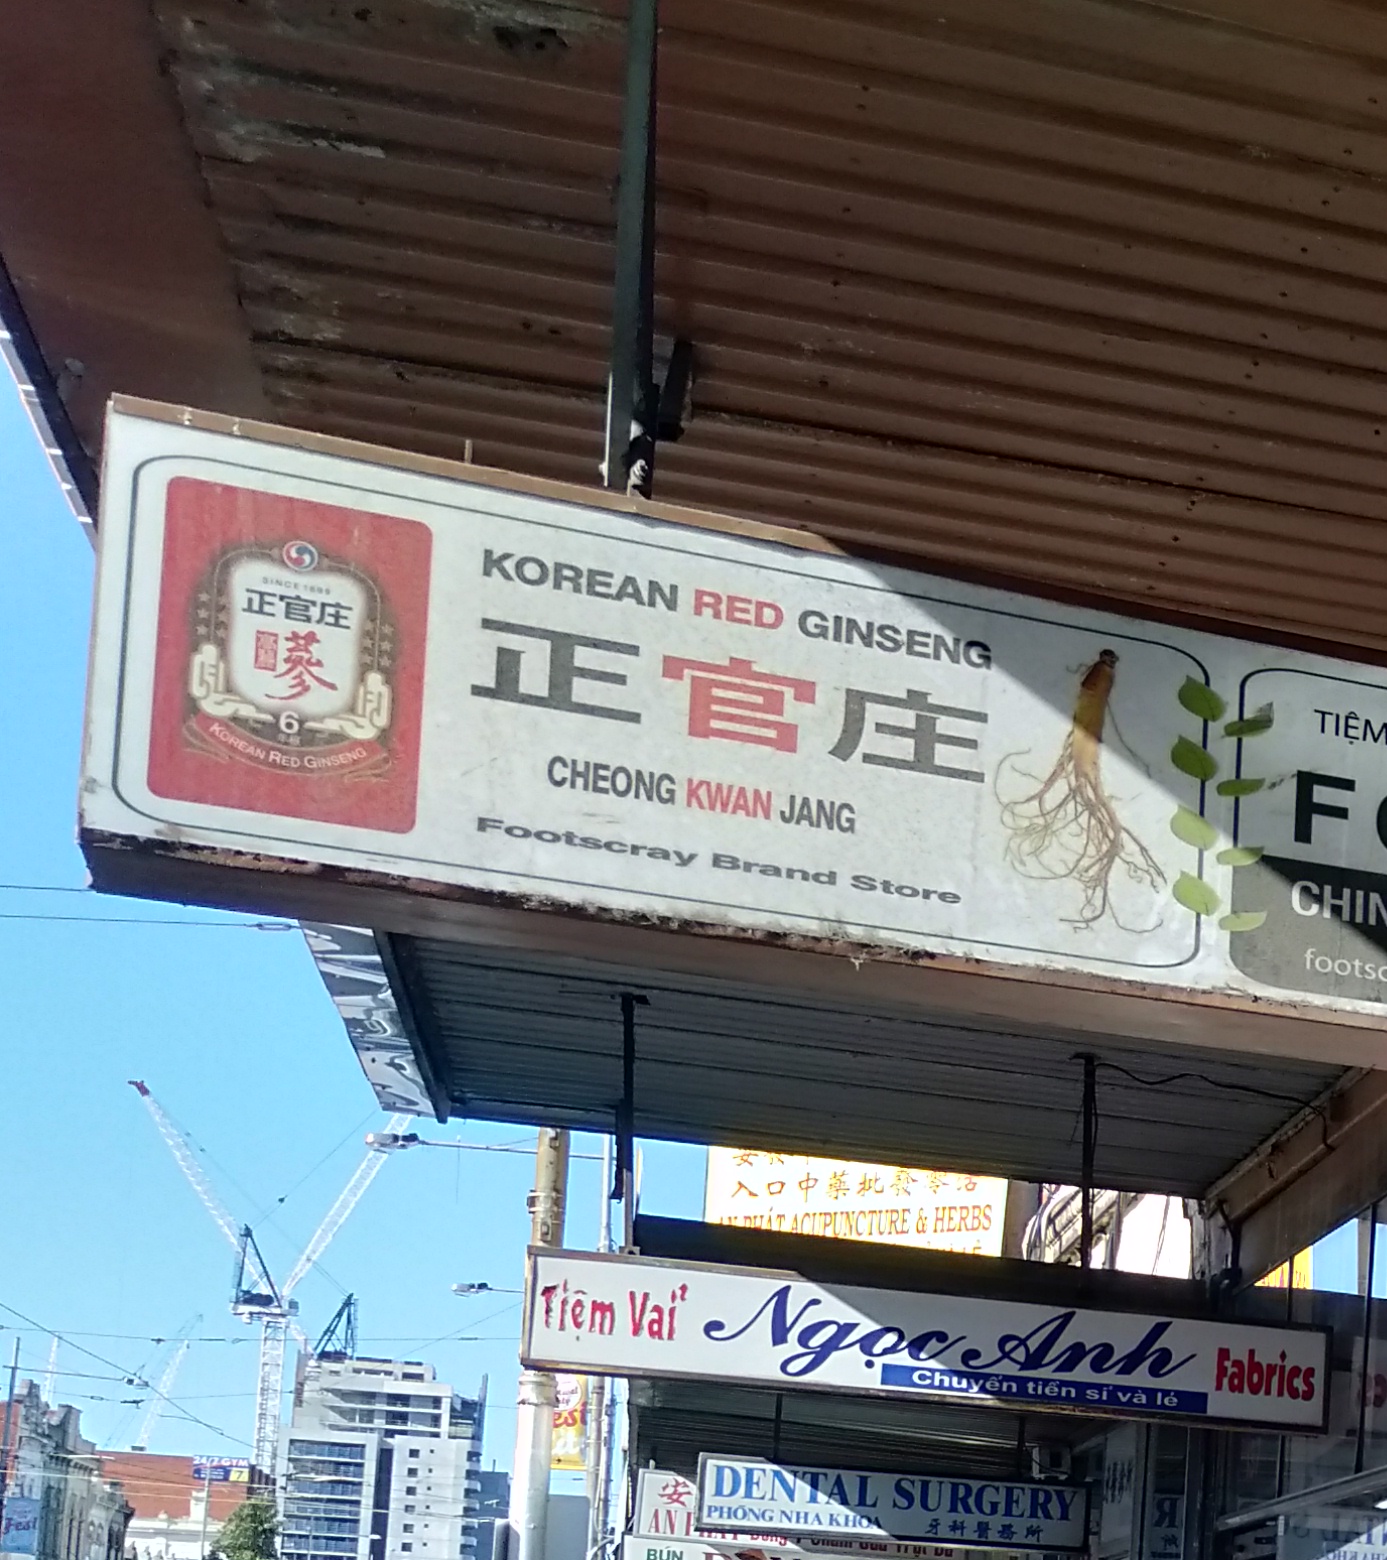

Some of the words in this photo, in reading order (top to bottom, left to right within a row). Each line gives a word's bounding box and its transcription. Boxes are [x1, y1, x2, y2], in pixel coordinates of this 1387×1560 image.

[262, 577, 299, 590] SINCE
[241, 587, 354, 629] 正官庄
[482, 549, 678, 612] KOREAN
[693, 589, 783, 630] RED
[798, 609, 993, 670] GINSENG
[470, 617, 988, 783] 正官庄
[278, 710, 300, 734] 6
[268, 750, 300, 768] RED
[303, 747, 368, 768] GINSENG
[547, 755, 675, 806] CHEONG
[686, 778, 771, 820] KWAN
[779, 794, 855, 834] JANG
[476, 817, 697, 867] Footscray
[711, 852, 836, 886] Brand
[850, 875, 961, 904] Store
[790, 1208, 912, 1238] ACUPUNCTURE
[915, 1207, 928, 1234] &
[933, 1204, 993, 1234] HERBS
[702, 1284, 967, 1377] Ngọc
[962, 1310, 1199, 1379] Anh
[1215, 1346, 1317, 1402] Fabrics
[1120, 1387, 1148, 1405] và
[221, 1457, 249, 1467] GYM
[657, 1476, 692, 1508] 安
[712, 1463, 879, 1508] DENTAL
[892, 1476, 1078, 1522] SURGERY
[649, 1508, 678, 1535] AN
[780, 1510, 823, 1526] NHA
[828, 1513, 882, 1530] KHOA
